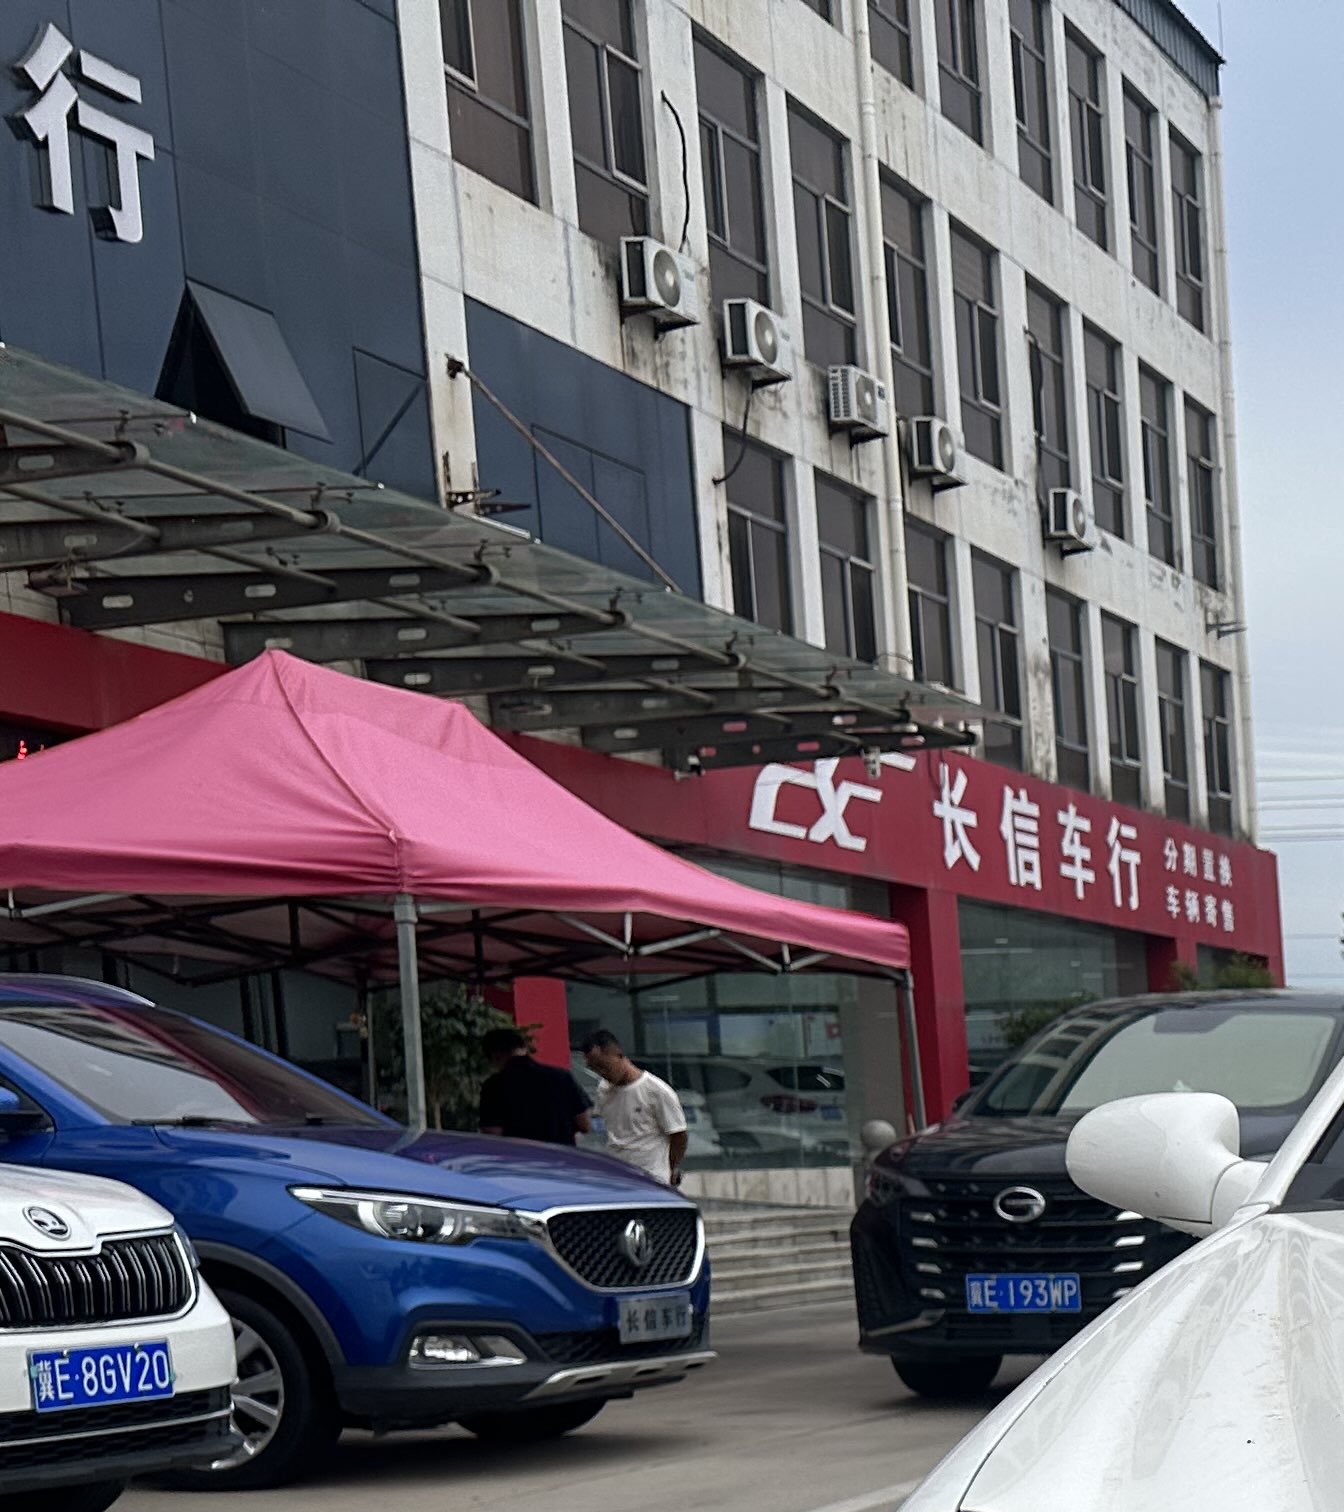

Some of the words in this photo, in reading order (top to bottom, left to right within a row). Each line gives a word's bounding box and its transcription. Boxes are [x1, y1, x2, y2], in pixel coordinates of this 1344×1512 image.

[15, 22, 156, 243] 行
[933, 762, 1142, 911] 长信车行
[1163, 837, 1233, 888] 分期置换
[626, 1305, 687, 1333] 长信车行
